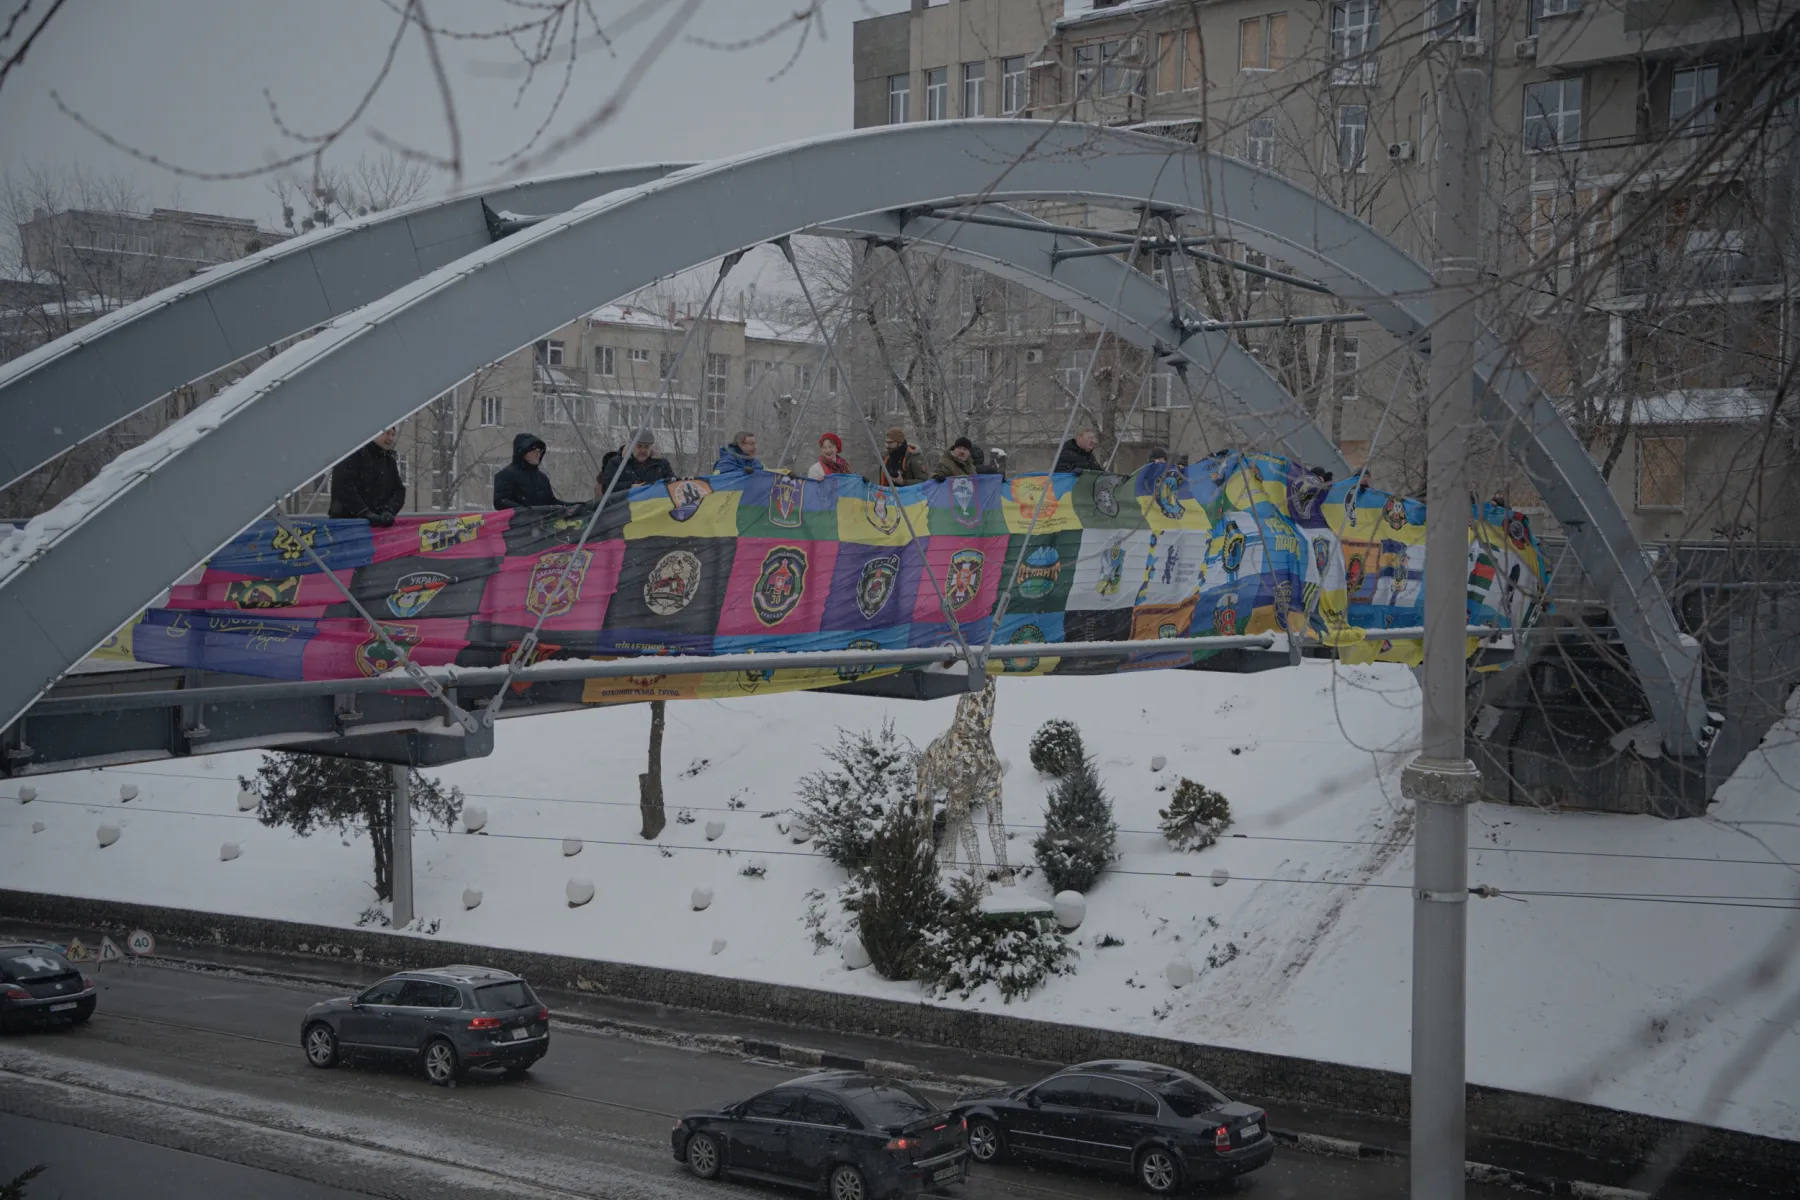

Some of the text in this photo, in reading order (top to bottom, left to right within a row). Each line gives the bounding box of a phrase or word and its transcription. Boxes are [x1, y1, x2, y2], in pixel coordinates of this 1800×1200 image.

[410, 575, 445, 585] УКРАЇ
[770, 595, 781, 604] 30
[134, 937, 149, 948] 40
